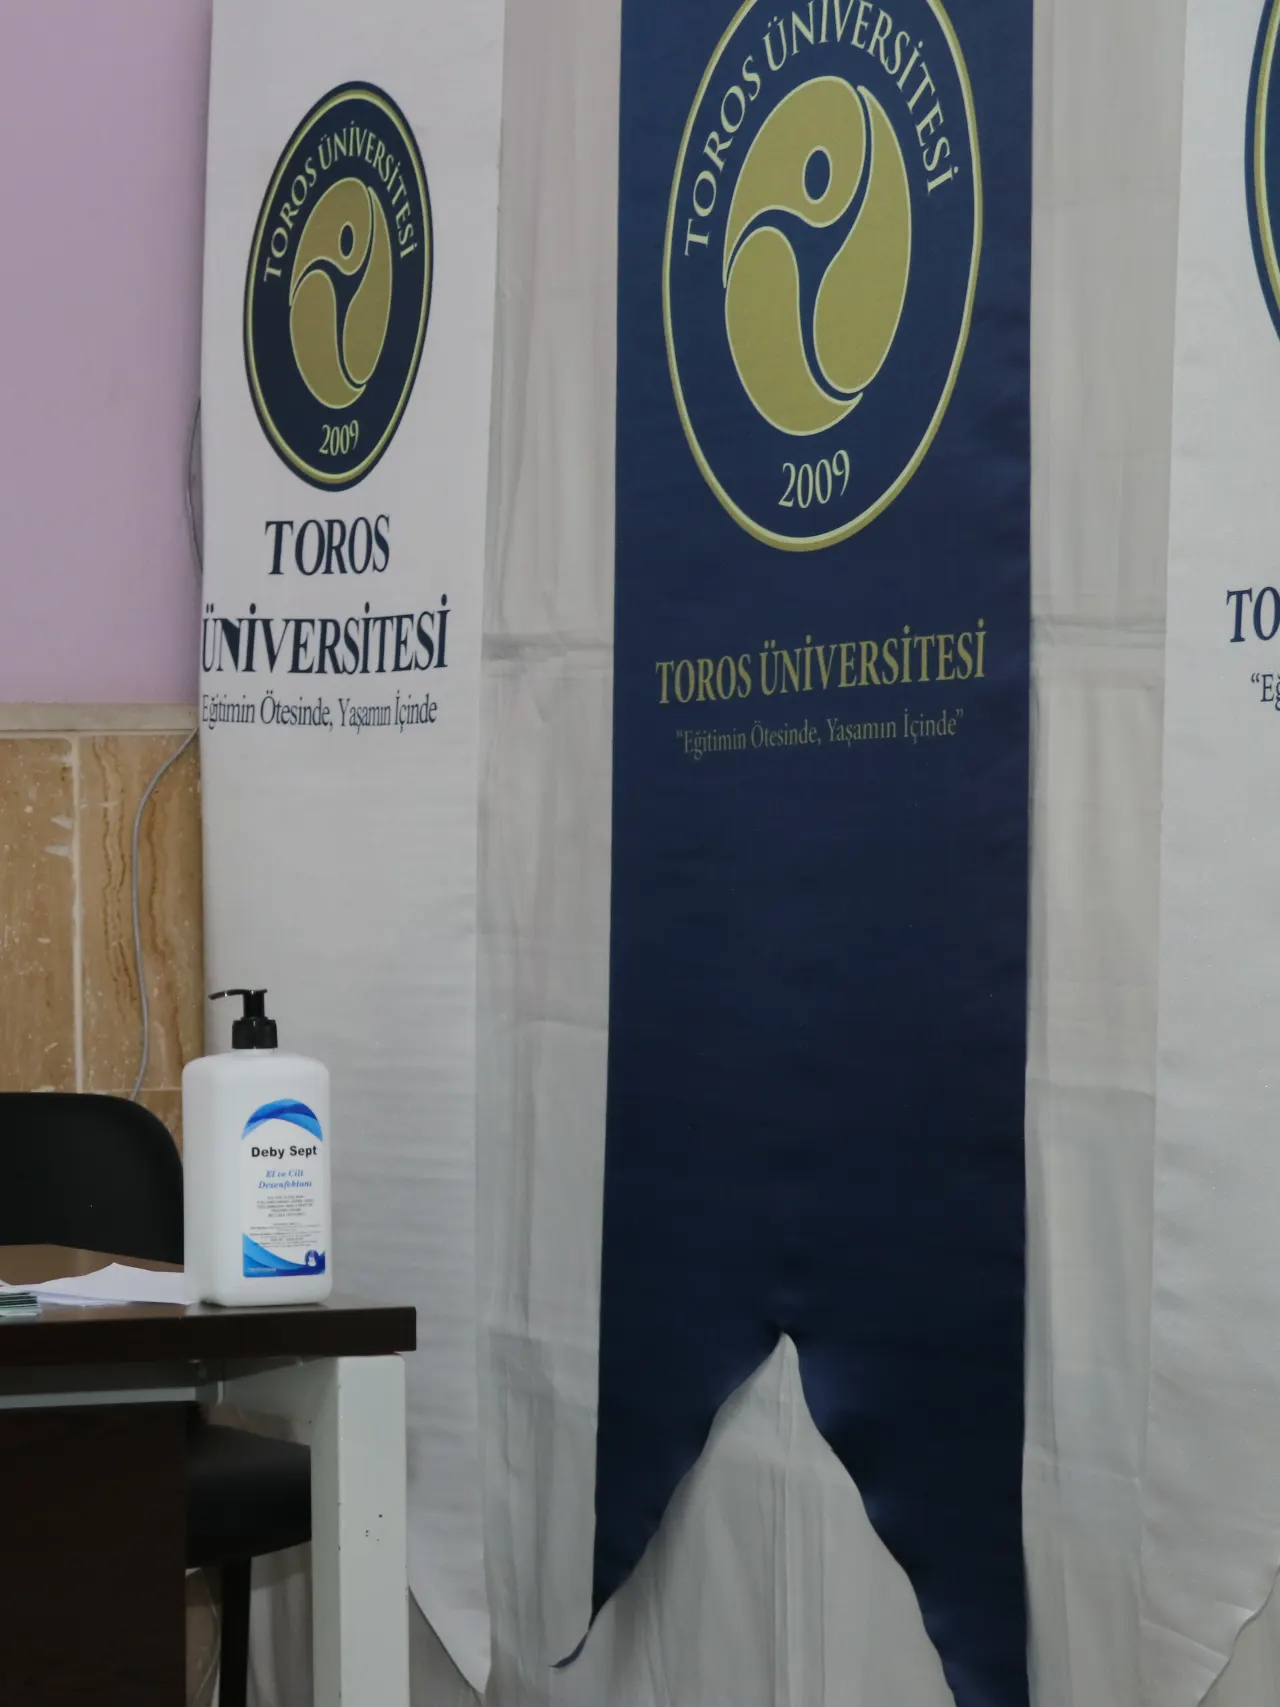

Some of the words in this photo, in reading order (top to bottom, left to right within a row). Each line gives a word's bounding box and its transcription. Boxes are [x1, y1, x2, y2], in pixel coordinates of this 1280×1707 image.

[684, 55, 761, 256] TOROS
[263, 157, 318, 283] TOROS
[318, 120, 418, 259] ÜNİVERSİTESİ
[319, 419, 360, 457] 2009
[778, 449, 851, 509] 2009
[264, 514, 390, 576] TOROS
[202, 593, 451, 676] ÜNİVERSİTESİ
[655, 653, 752, 704] TOROS
[759, 617, 987, 696] ÜNİVERSİTESİ
[260, 690, 333, 732] Ötesinde,
[338, 697, 392, 734] Yaşamın
[395, 689, 438, 733] İçinde
[826, 717, 898, 748] Yaşamın
[251, 1146, 285, 1160] Deby
[289, 1145, 317, 1158] Sept
